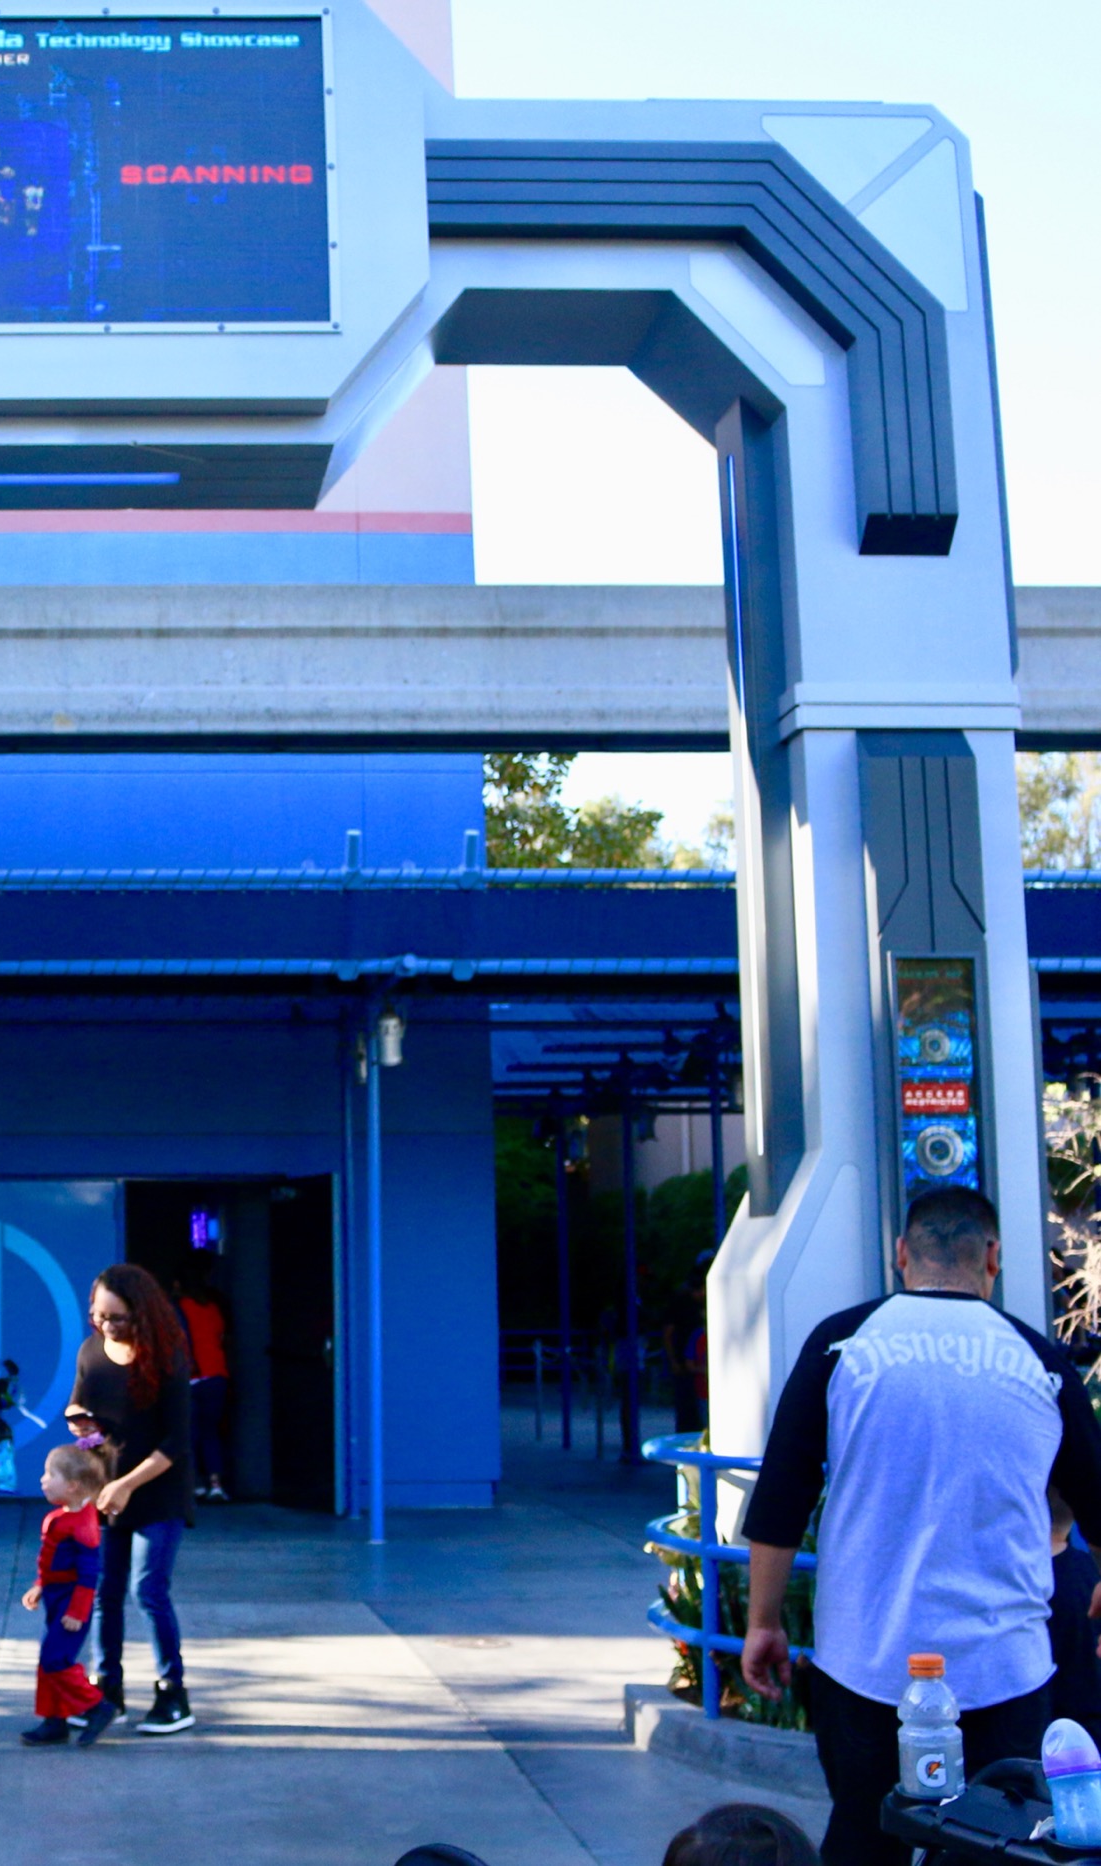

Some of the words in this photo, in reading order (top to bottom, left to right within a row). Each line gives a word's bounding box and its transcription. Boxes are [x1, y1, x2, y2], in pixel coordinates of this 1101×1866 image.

[35, 32, 172, 52] Technology
[180, 31, 300, 48] Showcase
[120, 164, 313, 185] SCANNING
[916, 1753, 947, 1789] G
